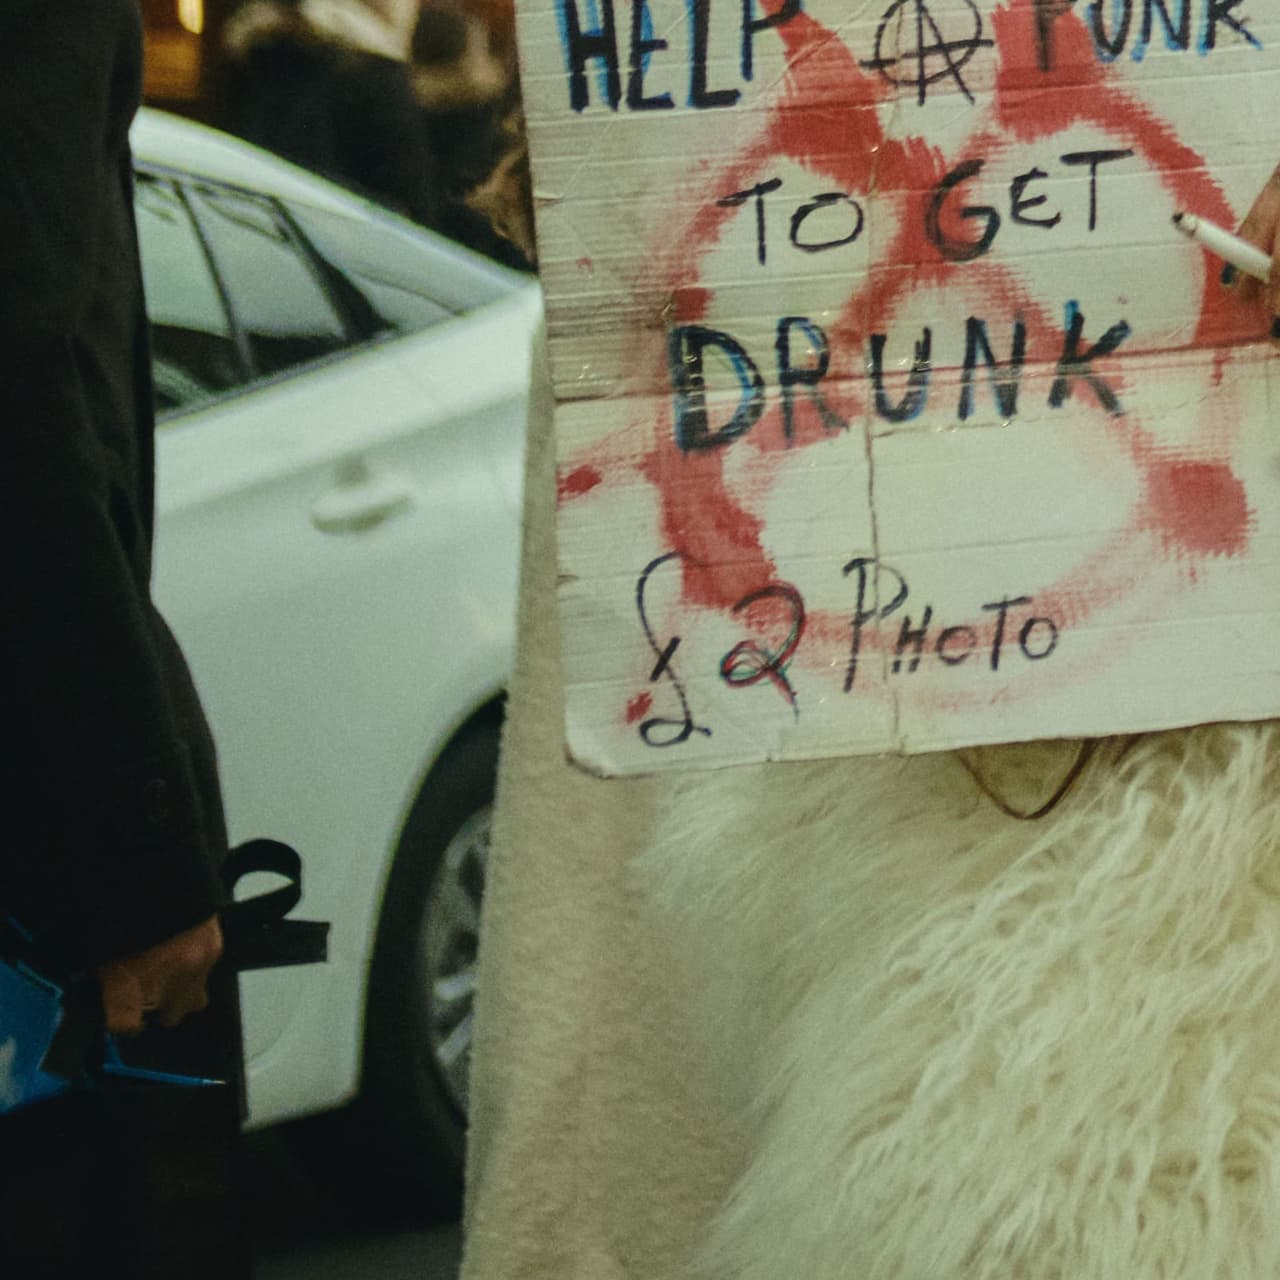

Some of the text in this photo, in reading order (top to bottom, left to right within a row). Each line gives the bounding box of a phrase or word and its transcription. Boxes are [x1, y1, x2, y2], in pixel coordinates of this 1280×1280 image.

[716, 148, 1134, 265] TO GET
[668, 299, 1133, 452] DRUNK
